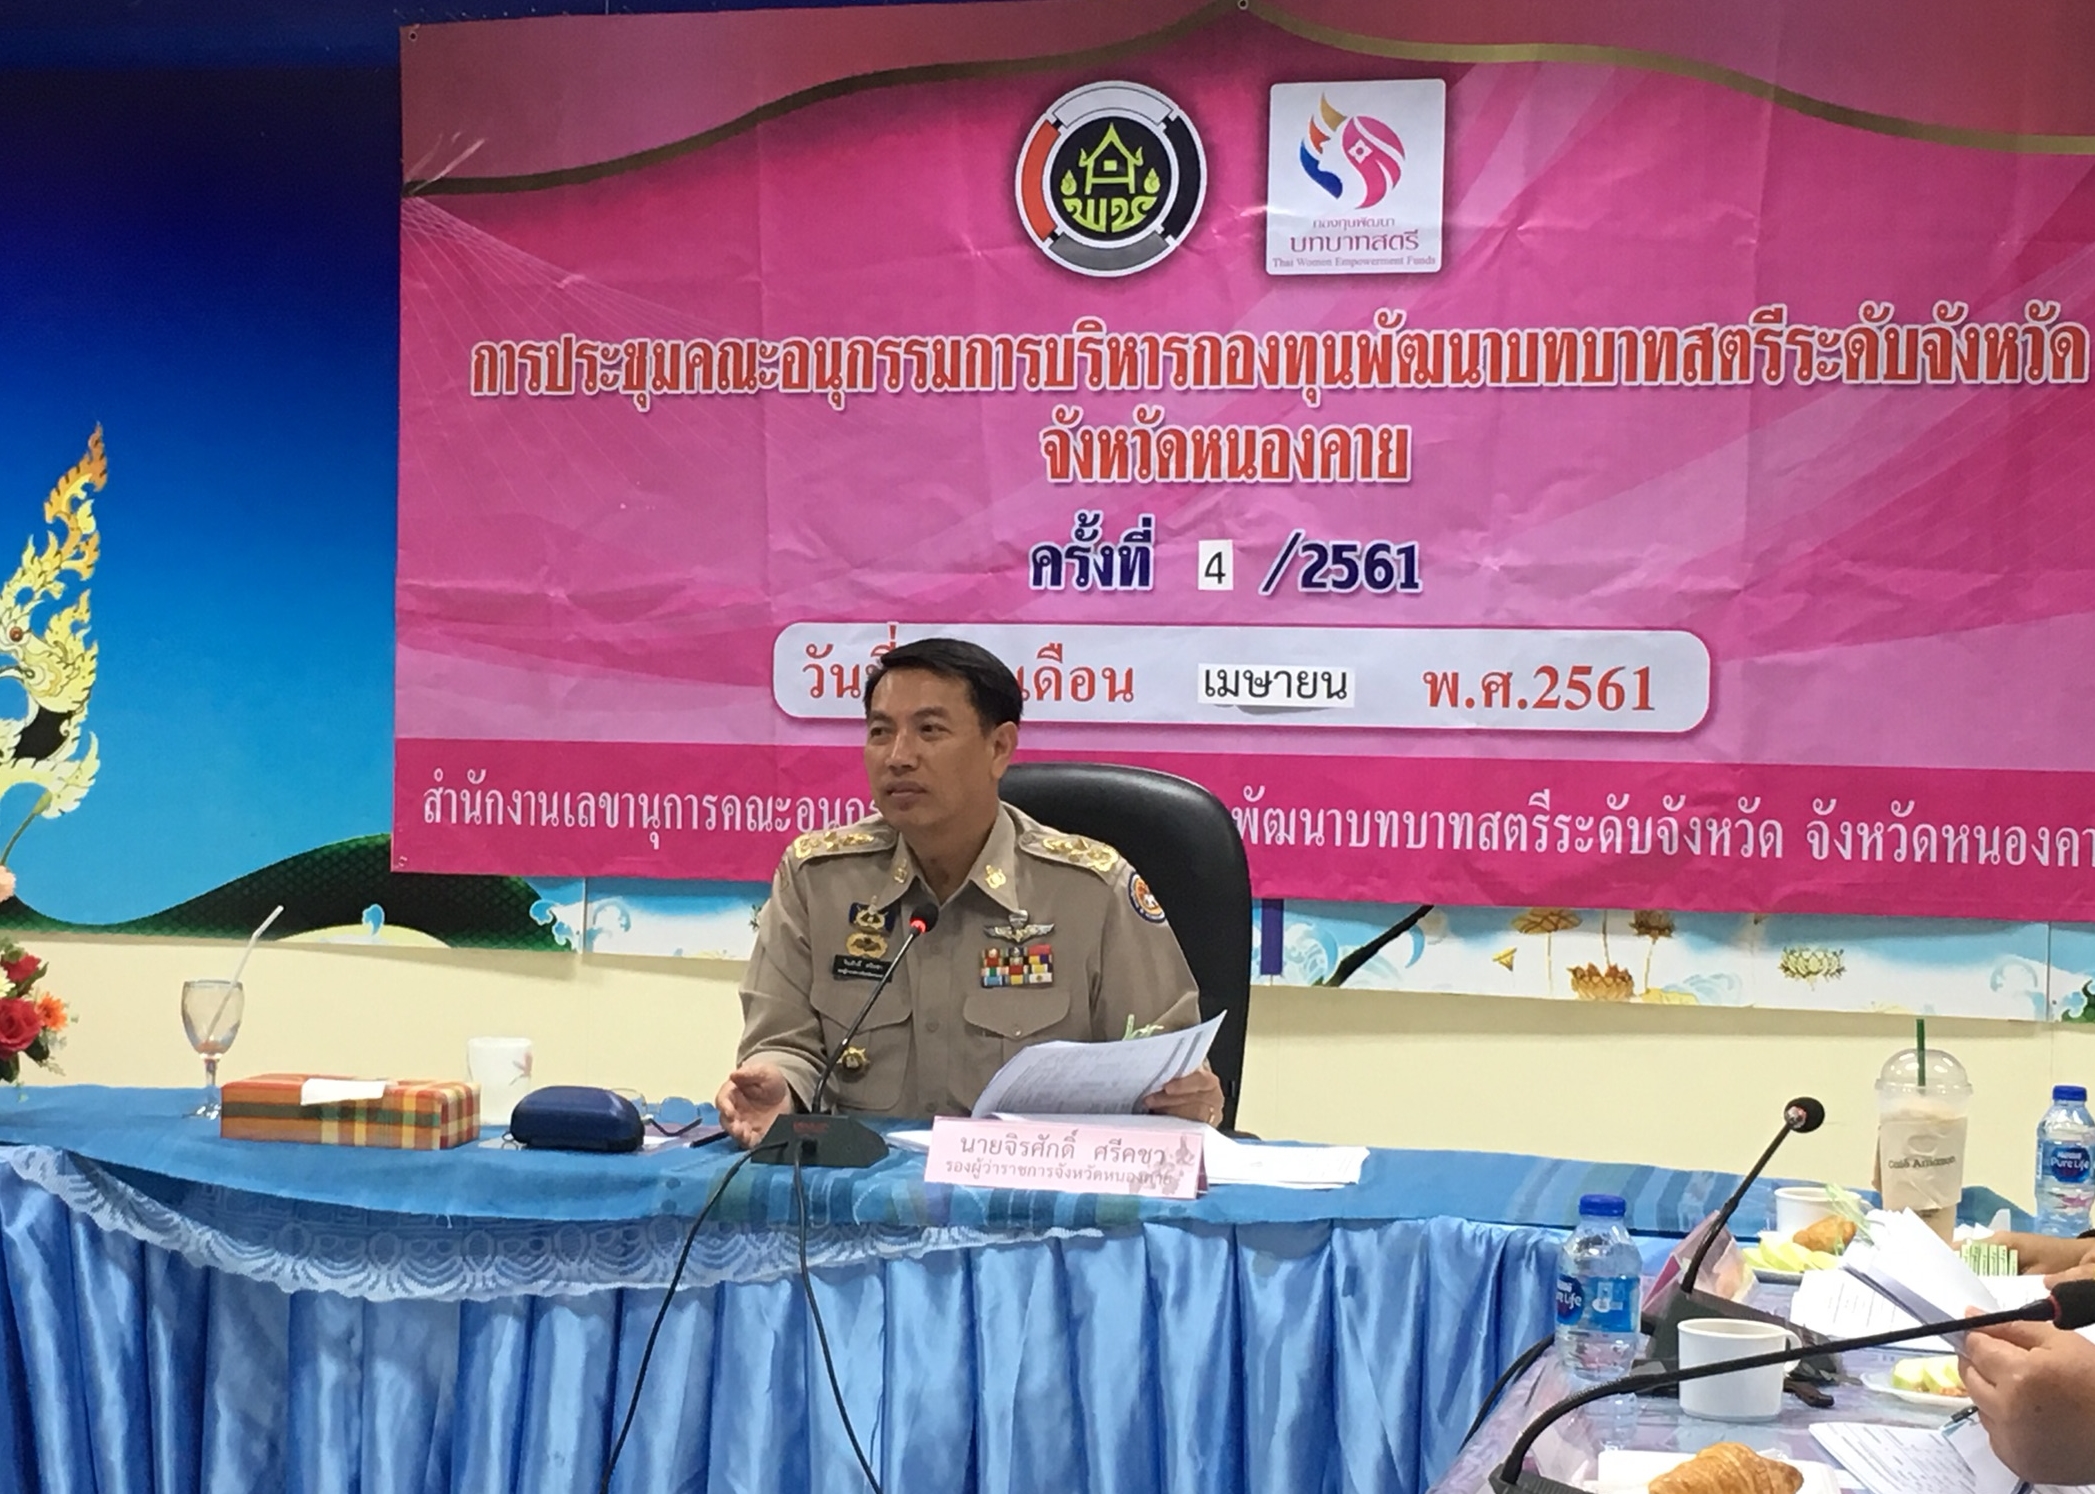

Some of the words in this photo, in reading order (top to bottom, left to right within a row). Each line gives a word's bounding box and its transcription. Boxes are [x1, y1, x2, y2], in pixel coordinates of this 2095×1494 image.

[1290, 229, 1420, 253] บทบาทสตรี
[1297, 257, 1332, 267] Women
[1335, 256, 1404, 269] Empowerment
[1406, 255, 1436, 266] Funds
[471, 301, 2089, 411] การประชุมคณะอนุกรรมการบริหารกองทุนพัฒนาบทบาทสตรีระดับจังหวัด
[1040, 404, 1411, 482] จังหวัดหนองคาย
[1029, 511, 1154, 589] ครั้งที่
[1203, 550, 1227, 585] 4
[1260, 529, 1422, 593] /2561
[1205, 669, 1347, 700] เมษายน
[1423, 665, 1655, 711] พ.ศ.2561
[960, 1129, 1079, 1159] นายจิรศักดิ์
